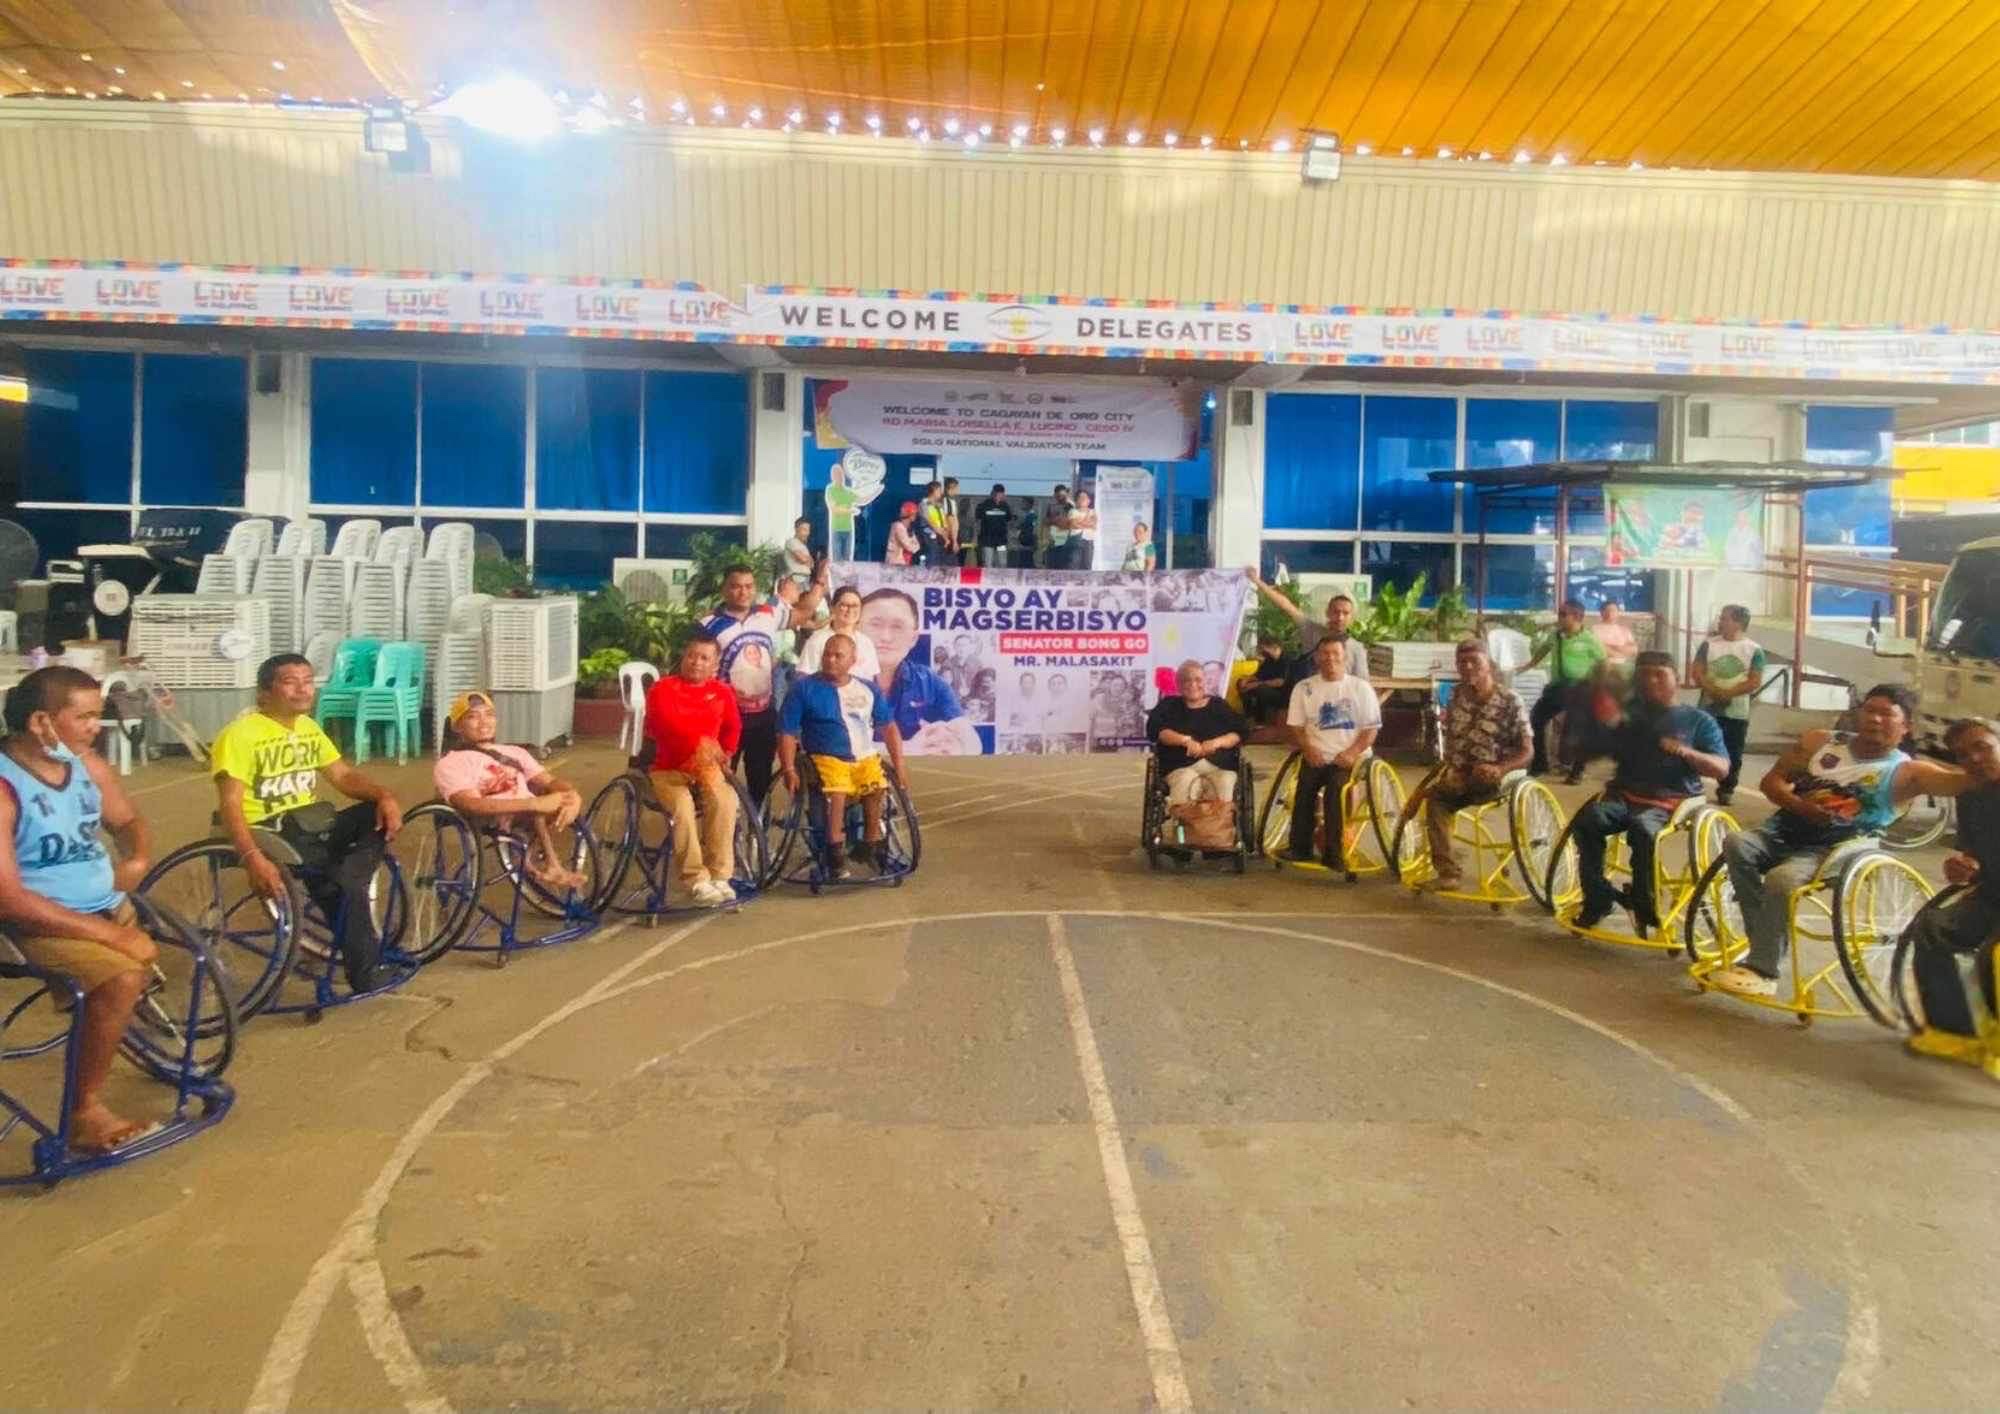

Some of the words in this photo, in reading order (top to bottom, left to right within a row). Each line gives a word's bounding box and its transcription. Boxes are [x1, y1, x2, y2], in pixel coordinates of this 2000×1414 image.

[0, 276, 64, 297] LOVE
[96, 279, 160, 299] LOVE
[193, 282, 258, 302] LOVE
[288, 284, 353, 305] LOVE
[385, 288, 448, 308] LOVE
[480, 290, 543, 312] LOVE
[575, 294, 640, 315] LOVE
[780, 305, 960, 332] WELCOME
[1077, 318, 1252, 342] DELEGATES
[1295, 322, 1352, 341] LOVE
[1381, 324, 1439, 343] LOVE
[1467, 325, 1521, 344] LOVE
[882, 405, 949, 416] WELCOME
[958, 408, 974, 417] TO
[980, 408, 1041, 419] CAGAYAN
[1047, 411, 1064, 420] DE
[1070, 412, 1099, 421] ORO
[1104, 412, 1134, 421] CITY
[904, 418, 947, 428] MARIA
[946, 440, 1001, 448] NATIONAL
[1006, 441, 1072, 450] VALIDATION
[1075, 442, 1107, 450] TEAM
[924, 587, 1016, 608] BISYO
[1024, 589, 1062, 609] AY
[923, 608, 1147, 632] MAGSERBISYO
[1002, 637, 1073, 650] SENATOR
[1078, 637, 1120, 650] BONG
[1124, 637, 1147, 650] GO
[1014, 656, 1041, 667] MR.
[1046, 656, 1136, 668] MALASAKIT
[254, 740, 321, 774] WORK
